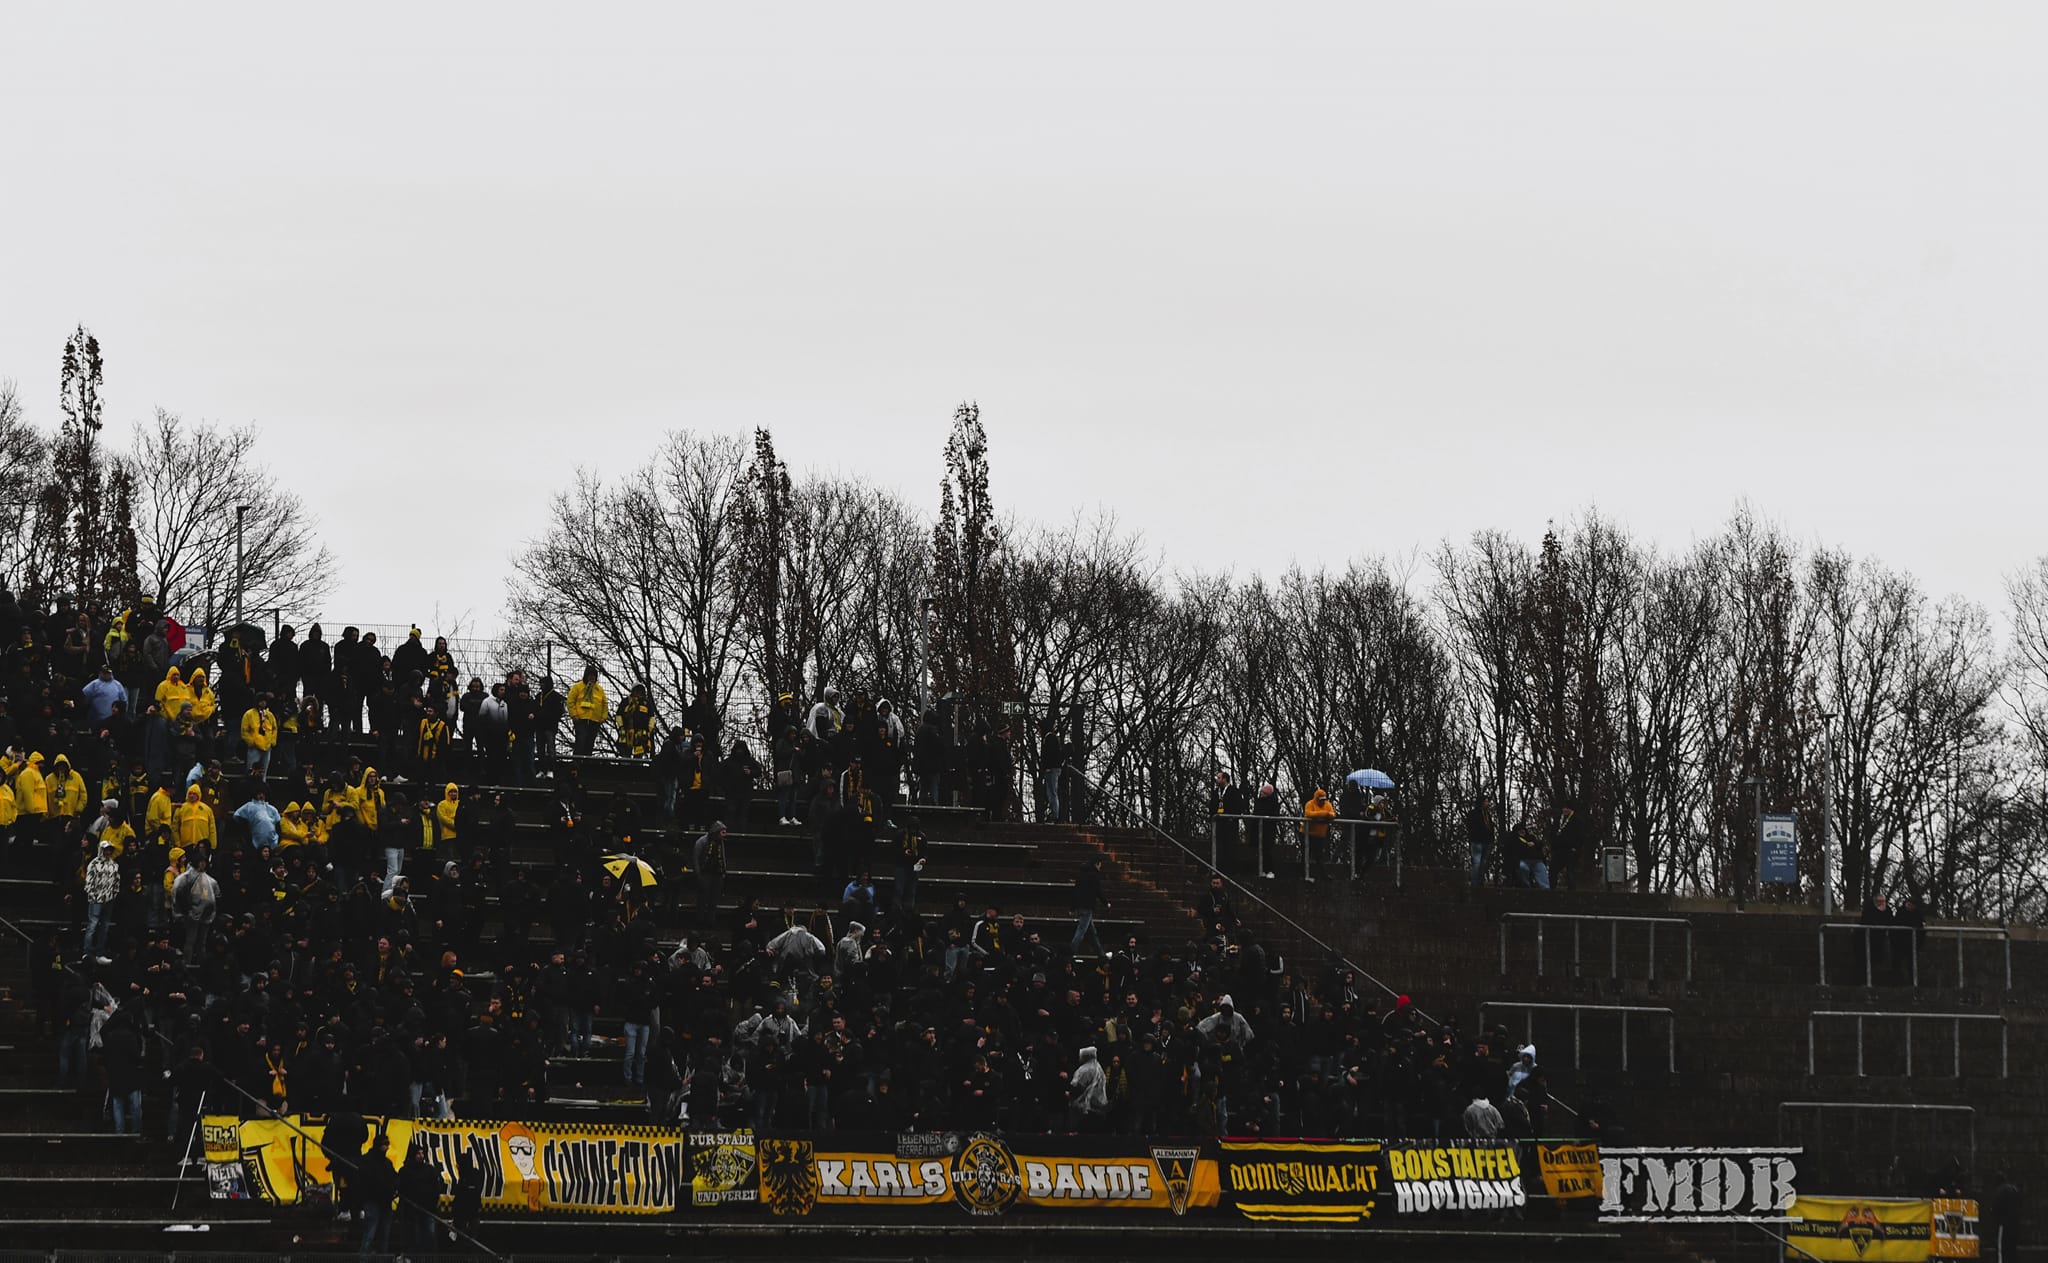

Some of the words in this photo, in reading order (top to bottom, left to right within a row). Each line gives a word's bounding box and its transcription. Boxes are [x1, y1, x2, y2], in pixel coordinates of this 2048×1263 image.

[717, 1133, 755, 1146] STADT
[897, 1134, 941, 1144] LEGENDEN
[543, 1138, 681, 1210] CONNECTION
[1230, 1163, 1280, 1192] DOM
[1305, 1165, 1378, 1193] WACHT
[1388, 1147, 1521, 1181] BOXSTAFFEL
[817, 1160, 948, 1197] KARLS
[1025, 1162, 1152, 1199] BANDE
[1393, 1176, 1526, 1213] HOOLIGANS
[696, 1191, 720, 1202] UND
[1811, 1223, 1837, 1235] Tigers
